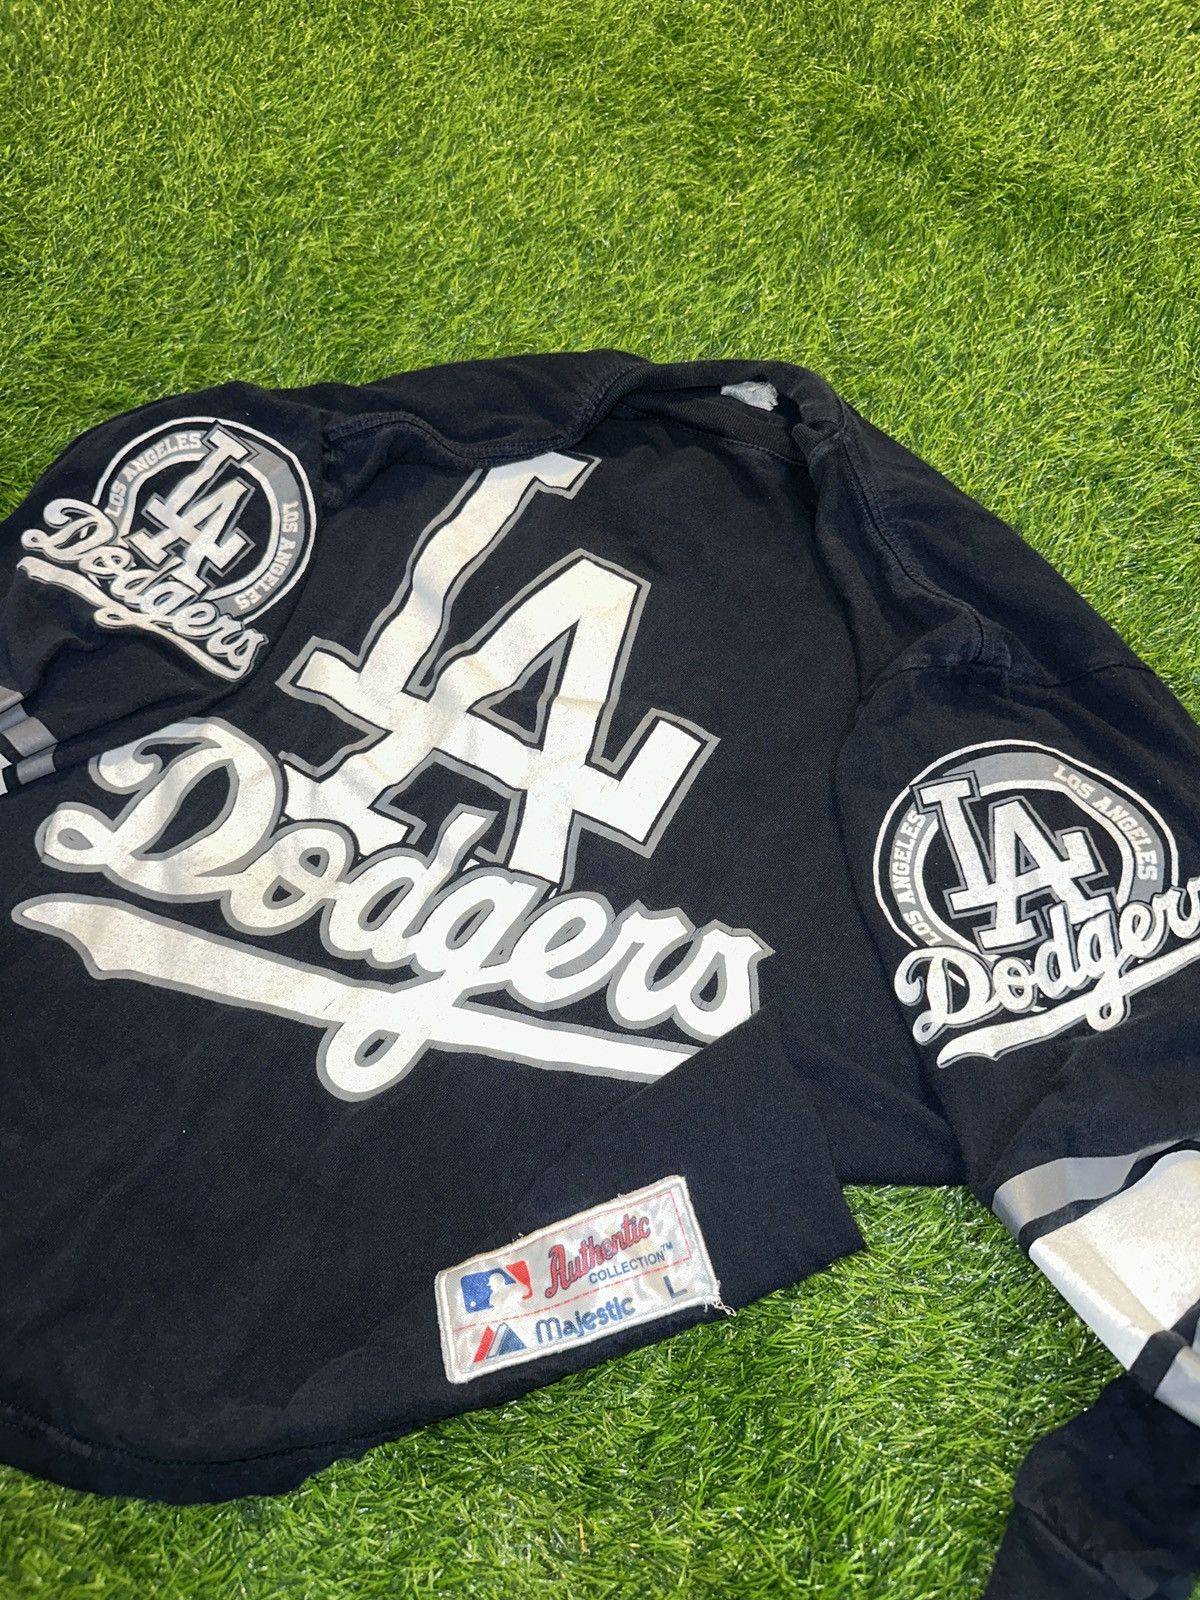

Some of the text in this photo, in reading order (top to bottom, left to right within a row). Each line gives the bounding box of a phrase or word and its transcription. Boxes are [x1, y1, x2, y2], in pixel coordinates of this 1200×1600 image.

[106, 431, 203, 517] LOS ANGELES
[18, 498, 268, 680] Dodgers
[234, 501, 300, 611] LOS ANGELES
[891, 809, 945, 946] LOS ANGELES
[914, 772, 1114, 950] LA
[1053, 764, 1158, 883] LOS ANGELES
[12, 716, 775, 1101] Dodgers
[534, 1275, 688, 1344] Majestic L
[544, 1213, 651, 1299] Authentic
